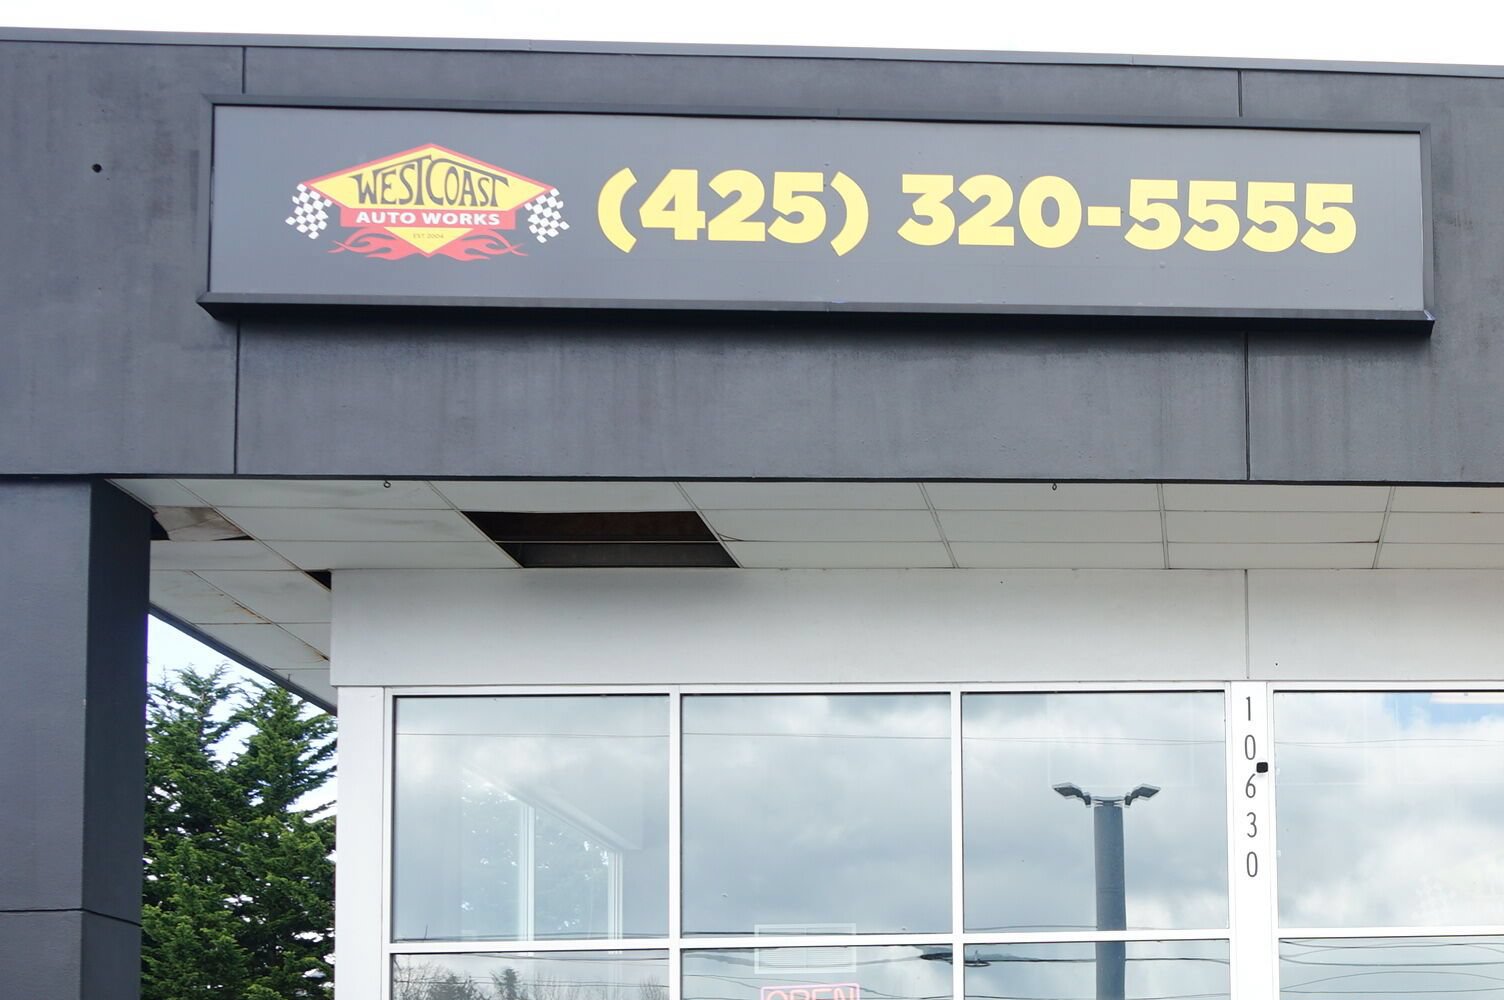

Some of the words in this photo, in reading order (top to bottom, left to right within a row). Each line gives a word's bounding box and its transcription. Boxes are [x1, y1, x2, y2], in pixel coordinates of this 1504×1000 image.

[355, 211, 417, 225] AUTO
[421, 212, 501, 226] WORKS
[597, 166, 869, 257] (425)
[897, 173, 1358, 254] 320-5555
[1244, 696, 1259, 878] 10630
